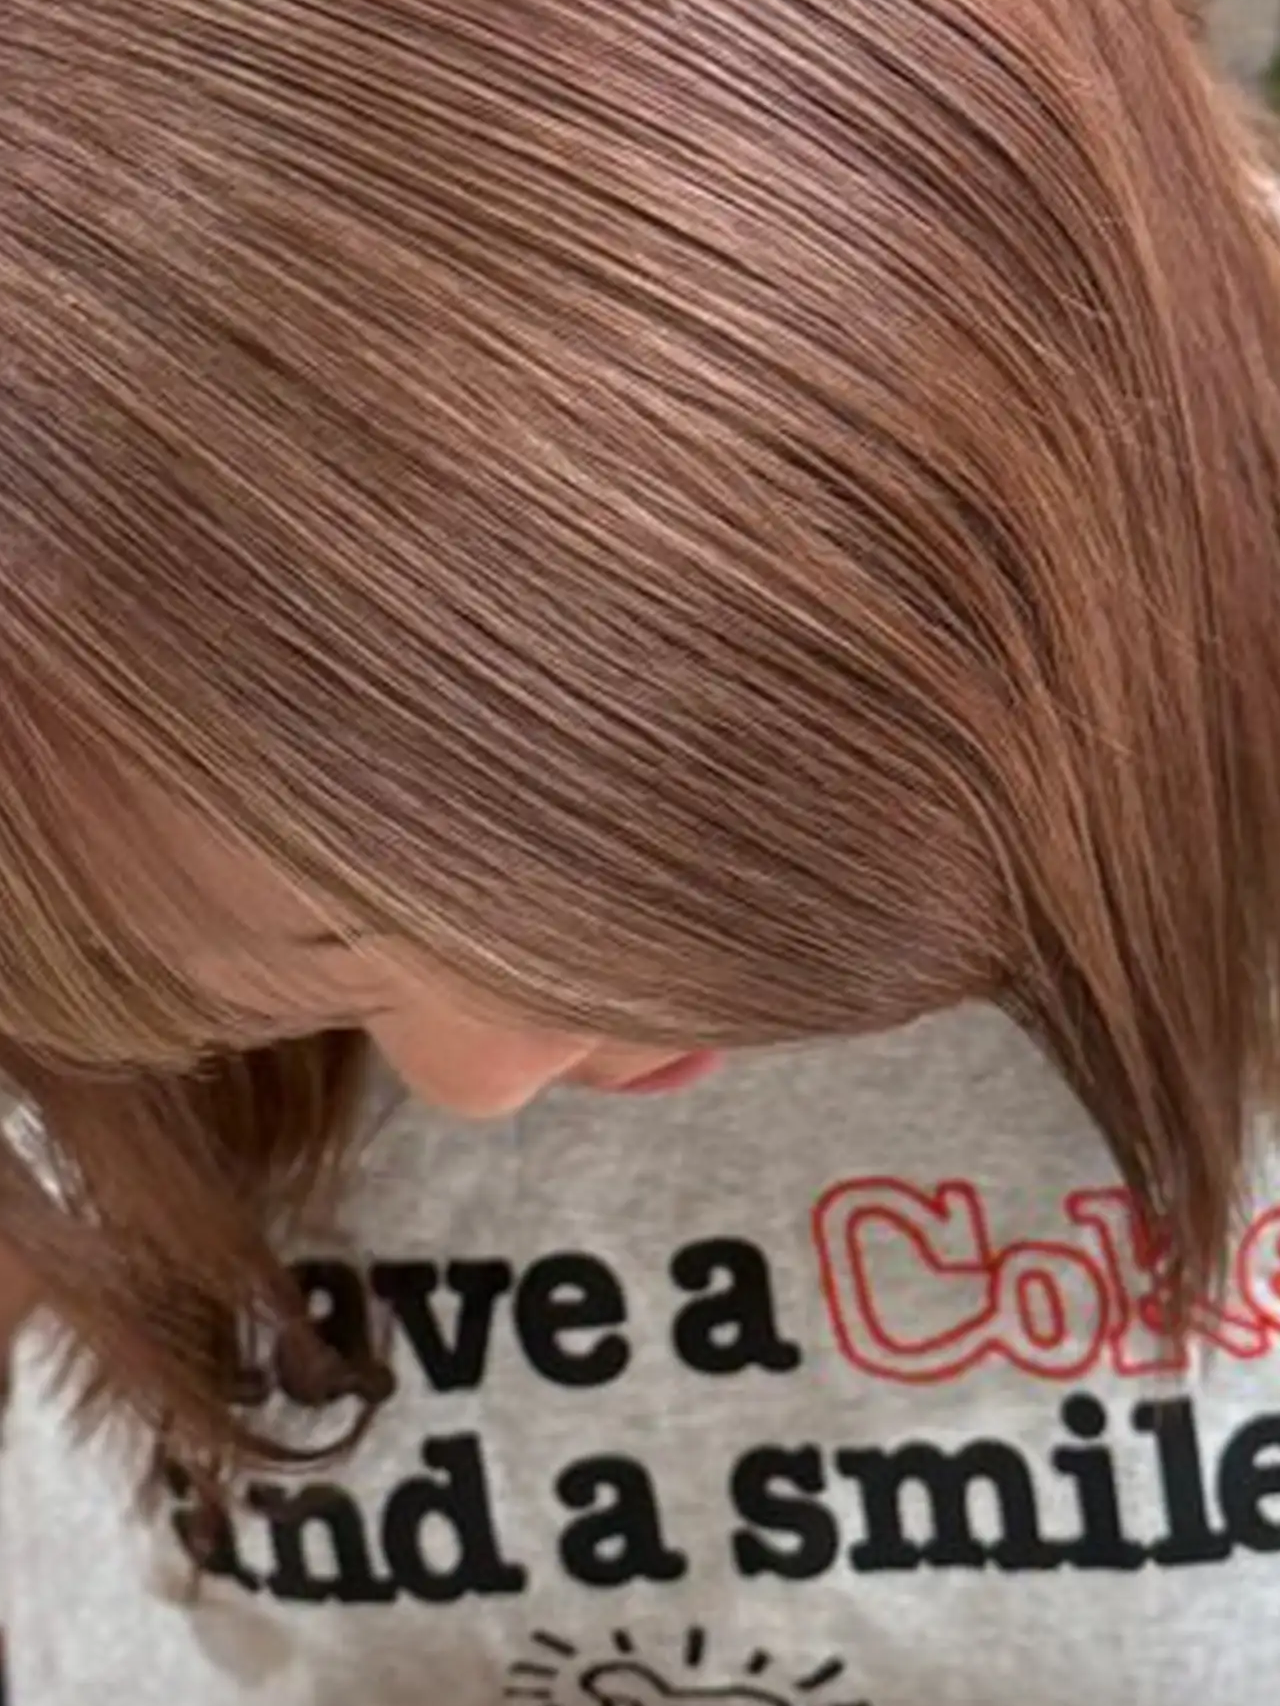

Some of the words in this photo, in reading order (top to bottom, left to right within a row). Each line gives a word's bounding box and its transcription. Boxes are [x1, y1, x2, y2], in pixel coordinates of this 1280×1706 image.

[232, 1253, 631, 1403] ave
[670, 1237, 803, 1376] a
[555, 1456, 688, 1590] a
